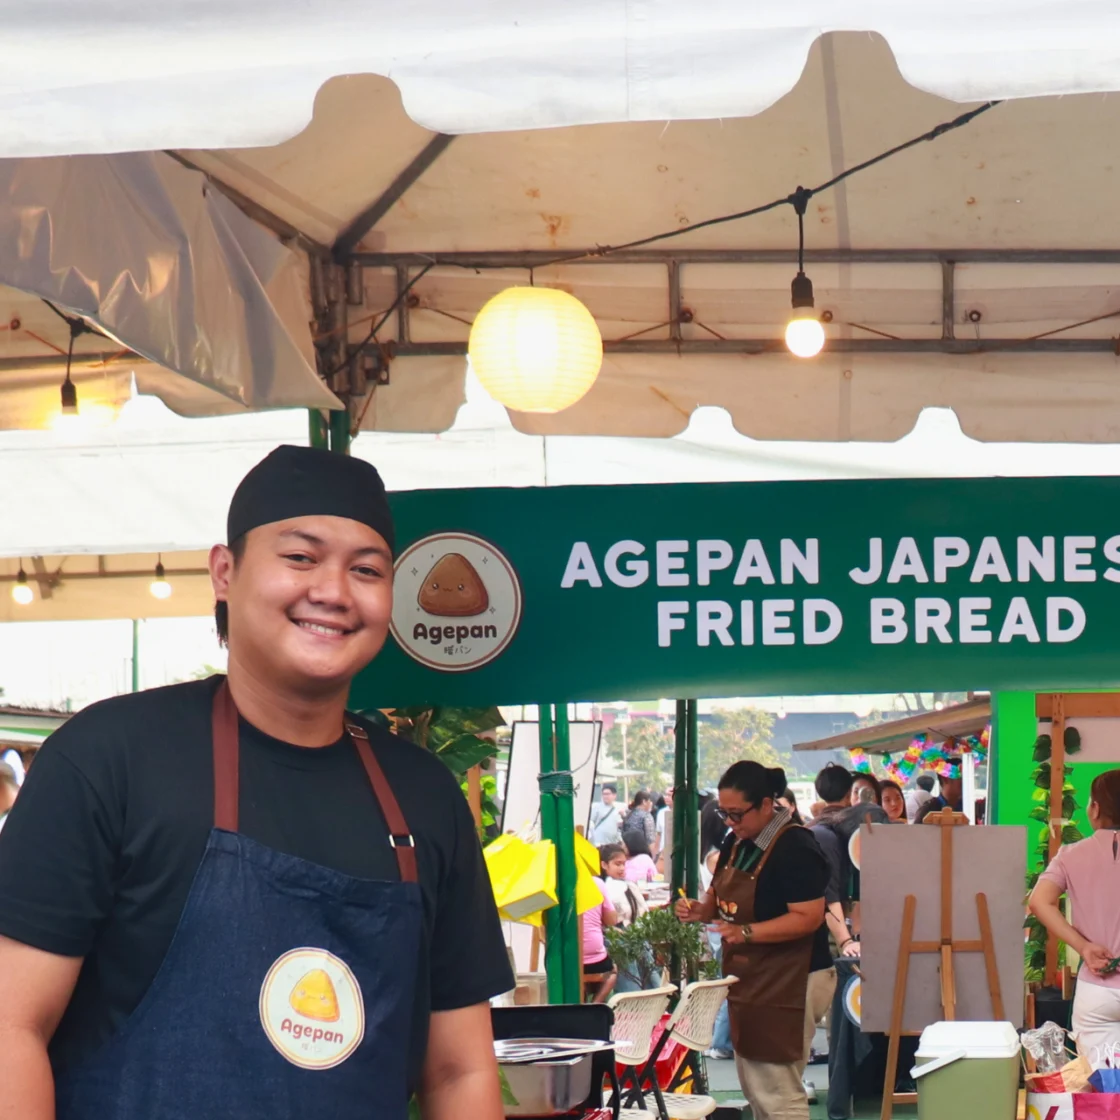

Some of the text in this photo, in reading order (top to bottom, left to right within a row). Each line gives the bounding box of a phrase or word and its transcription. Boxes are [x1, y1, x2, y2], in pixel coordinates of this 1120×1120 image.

[560, 538, 820, 589] AGEPAN
[413, 623, 497, 645] Agepan
[657, 596, 1087, 648] FRIED BREAD
[281, 1018, 344, 1044] Agepan
